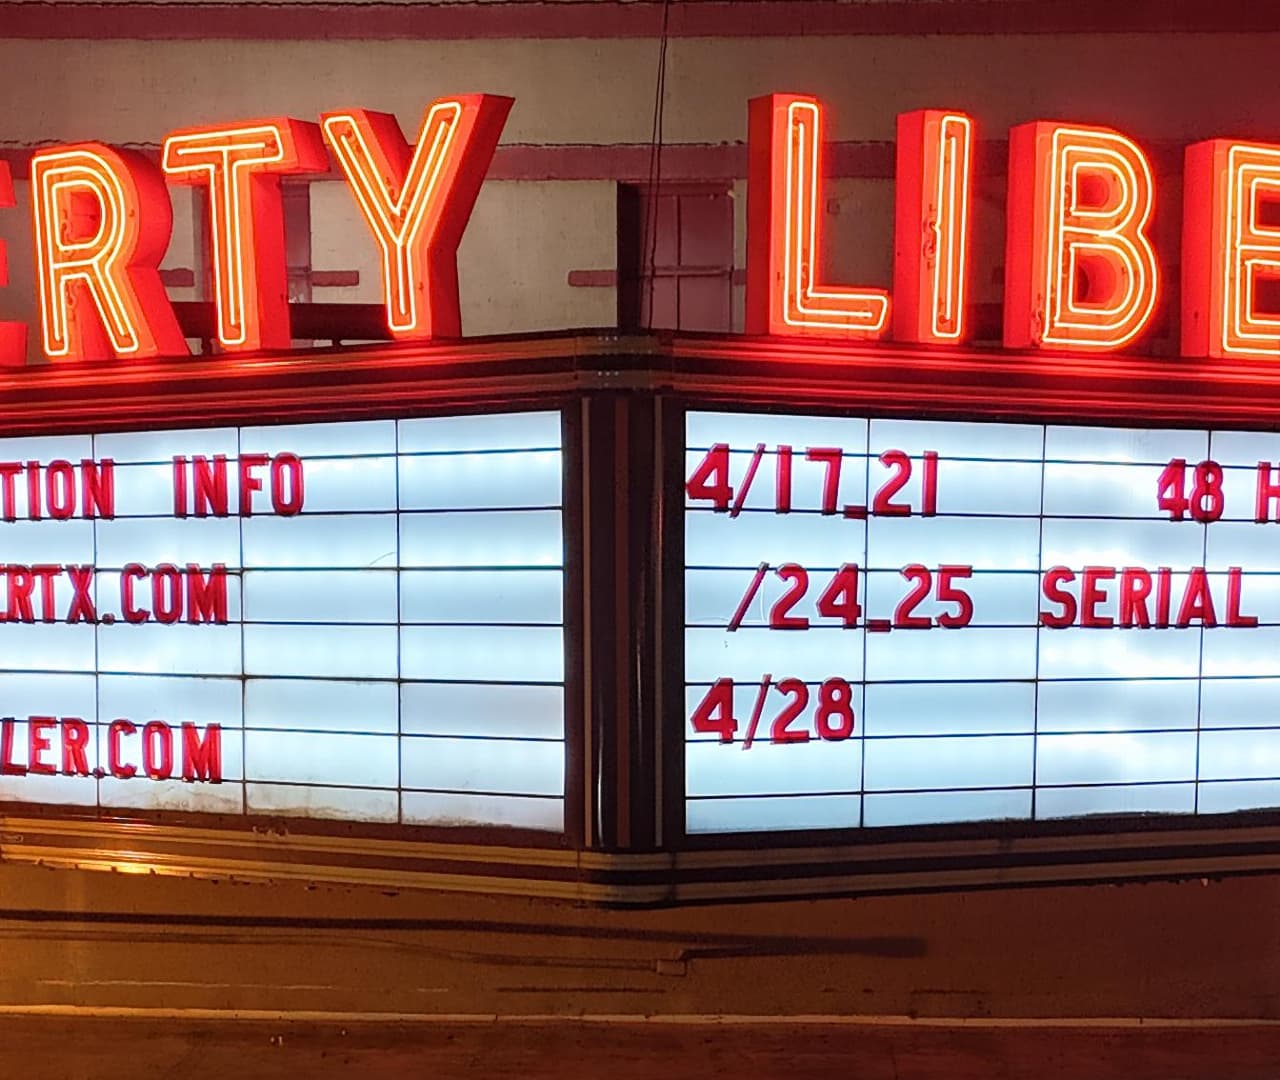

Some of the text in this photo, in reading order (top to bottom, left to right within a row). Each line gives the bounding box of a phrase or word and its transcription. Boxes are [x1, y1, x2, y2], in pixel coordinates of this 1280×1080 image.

[172, 452, 304, 519] INFO
[1156, 458, 1225, 524] 48
[1039, 566, 1259, 630] SERIAL
[690, 673, 855, 752] 4/28
